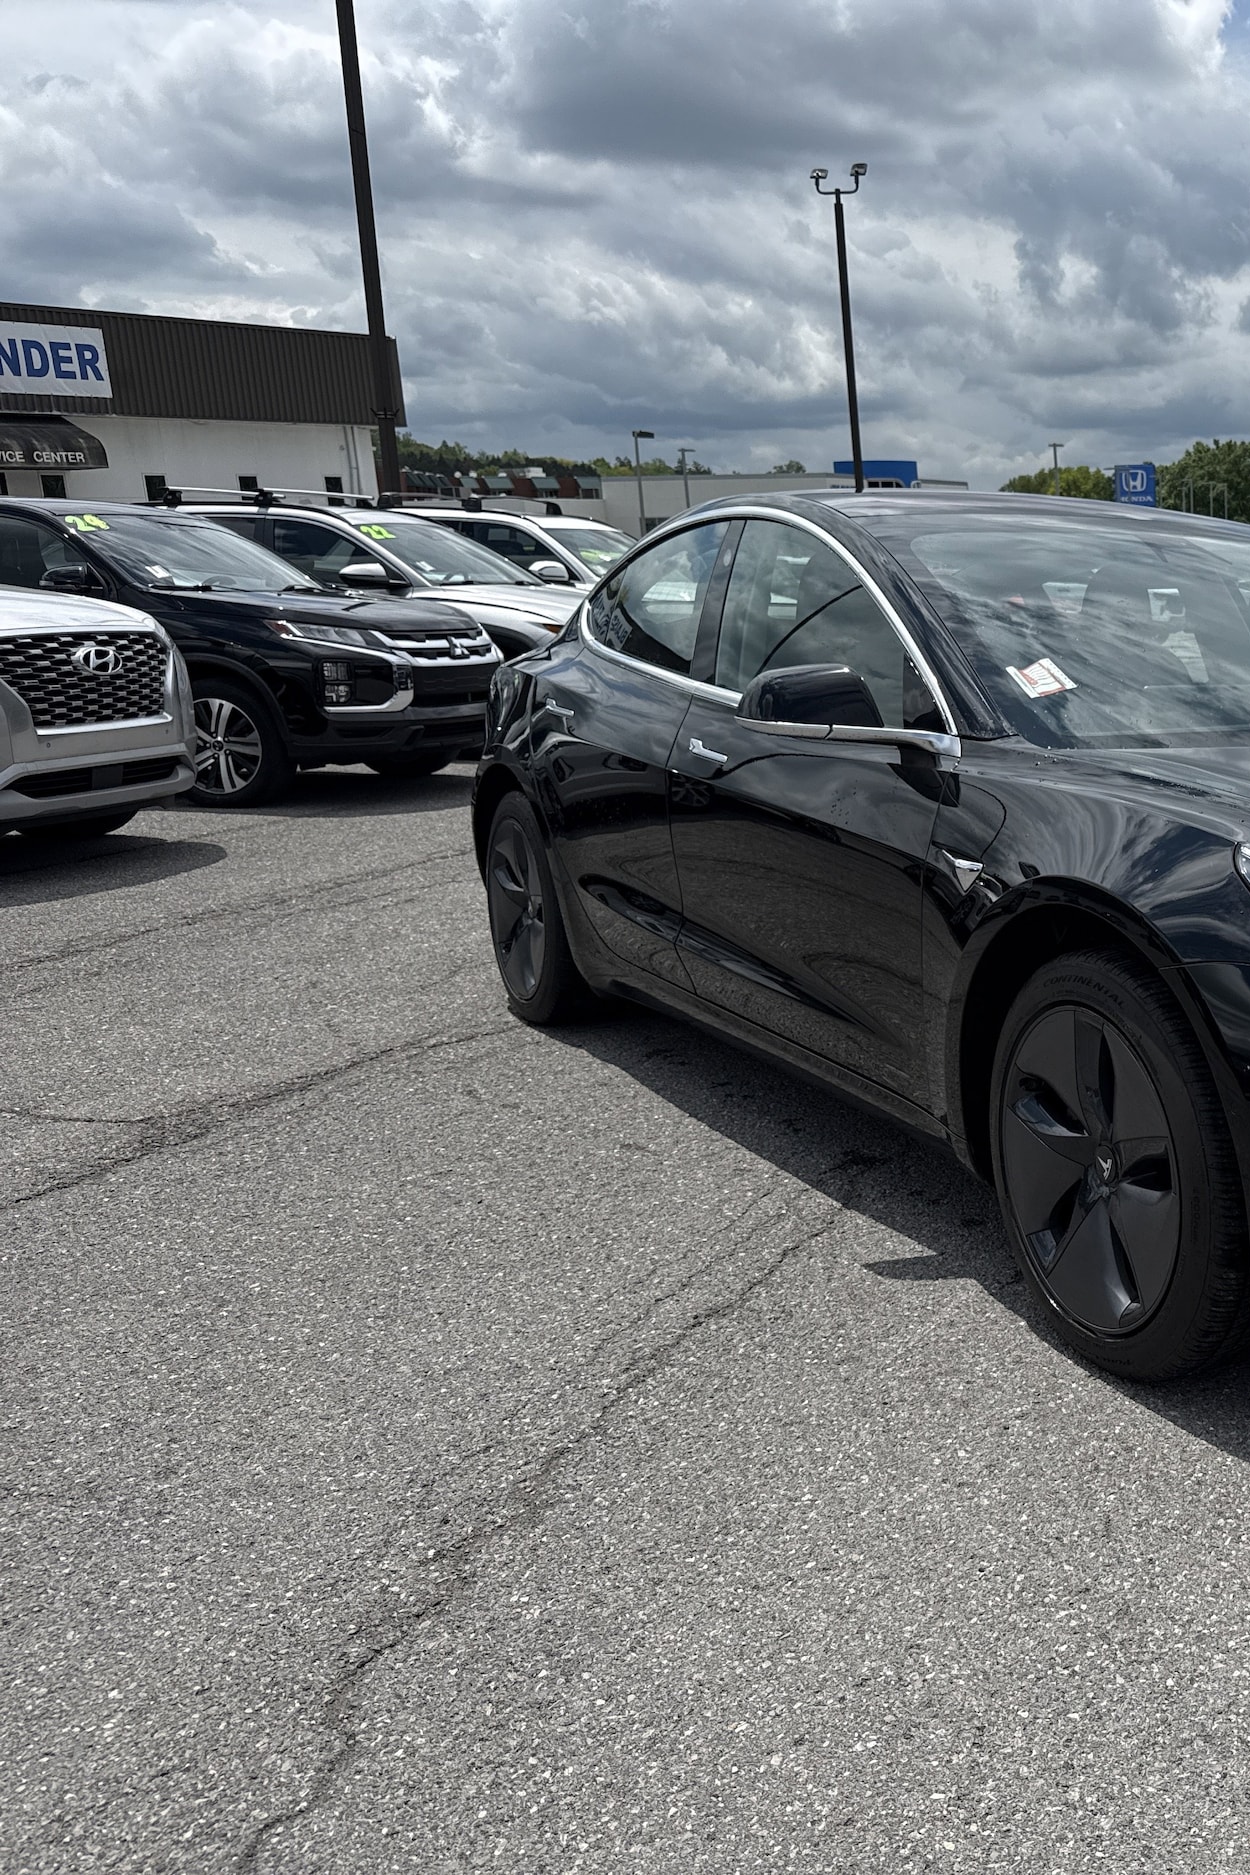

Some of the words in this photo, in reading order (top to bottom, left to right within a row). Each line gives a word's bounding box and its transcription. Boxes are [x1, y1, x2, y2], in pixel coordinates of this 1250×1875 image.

[0, 338, 104, 381] NDER
[0, 450, 25, 463] ICE
[33, 451, 85, 463] CENTER
[360, 524, 397, 540] 22
